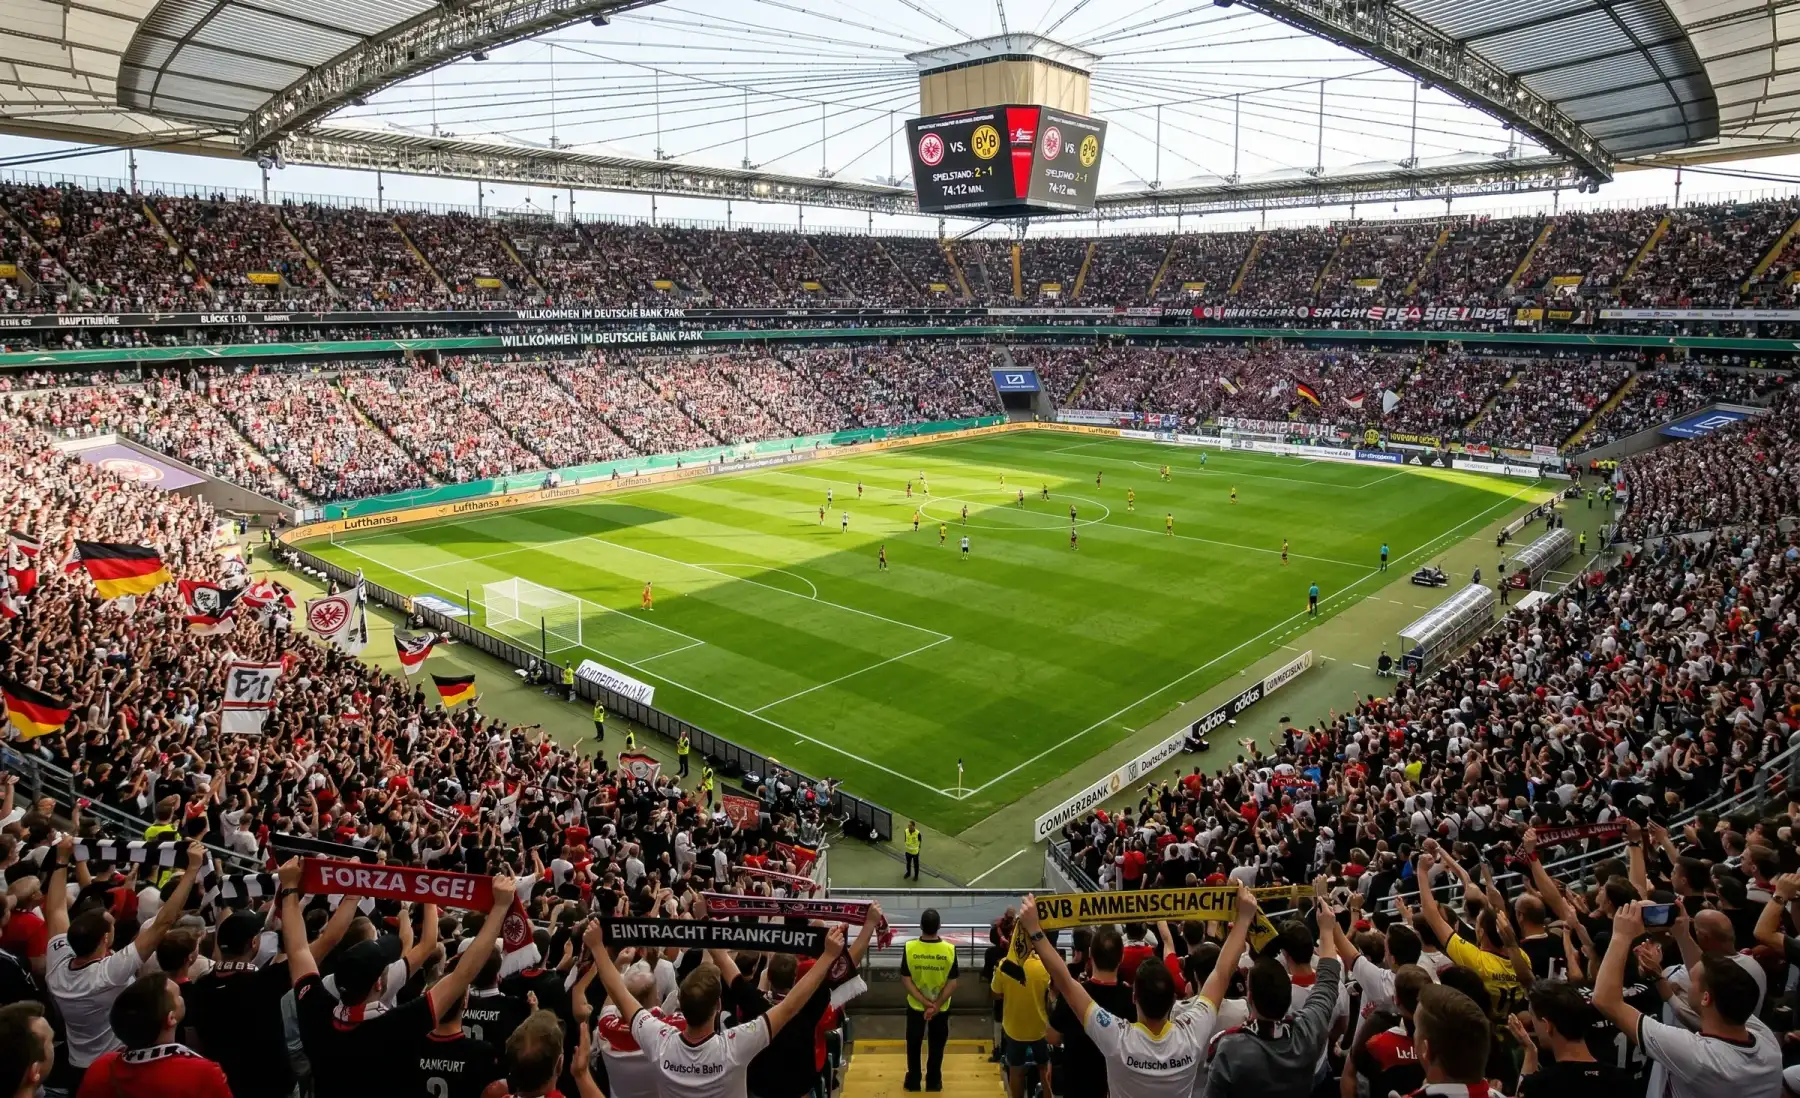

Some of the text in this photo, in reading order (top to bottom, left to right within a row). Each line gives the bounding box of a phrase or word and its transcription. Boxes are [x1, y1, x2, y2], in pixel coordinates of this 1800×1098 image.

[949, 141, 967, 153] VS.
[976, 129, 996, 150] BVB
[1064, 142, 1076, 154] VS.
[974, 167, 981, 178] 2
[987, 166, 993, 176] 1
[1074, 172, 1080, 182] 2
[942, 184, 967, 196] 74:12
[1048, 182, 1067, 195] 74:12
[230, 314, 247, 323] 1-10
[516, 308, 686, 319] WILLKOMMEN IM DEUTSCHE BANK PARK
[500, 330, 704, 347] WILLKOMMEN IM DEUTSCHE BANK PARK
[453, 499, 500, 513] Lufthansa
[344, 514, 398, 530] Lufthansa
[1234, 687, 1260, 713] adidas
[1198, 709, 1226, 737] adidas
[1039, 783, 1109, 835] COMMERZBANK
[320, 866, 475, 901] FORZA SGE!
[1037, 891, 1238, 921] BVB AMMENSCHACHT
[611, 923, 817, 948] EINTRACHT FRANKFURT
[419, 1058, 466, 1073] RANKFURT
[663, 1059, 724, 1075] Deutsche Bahn
